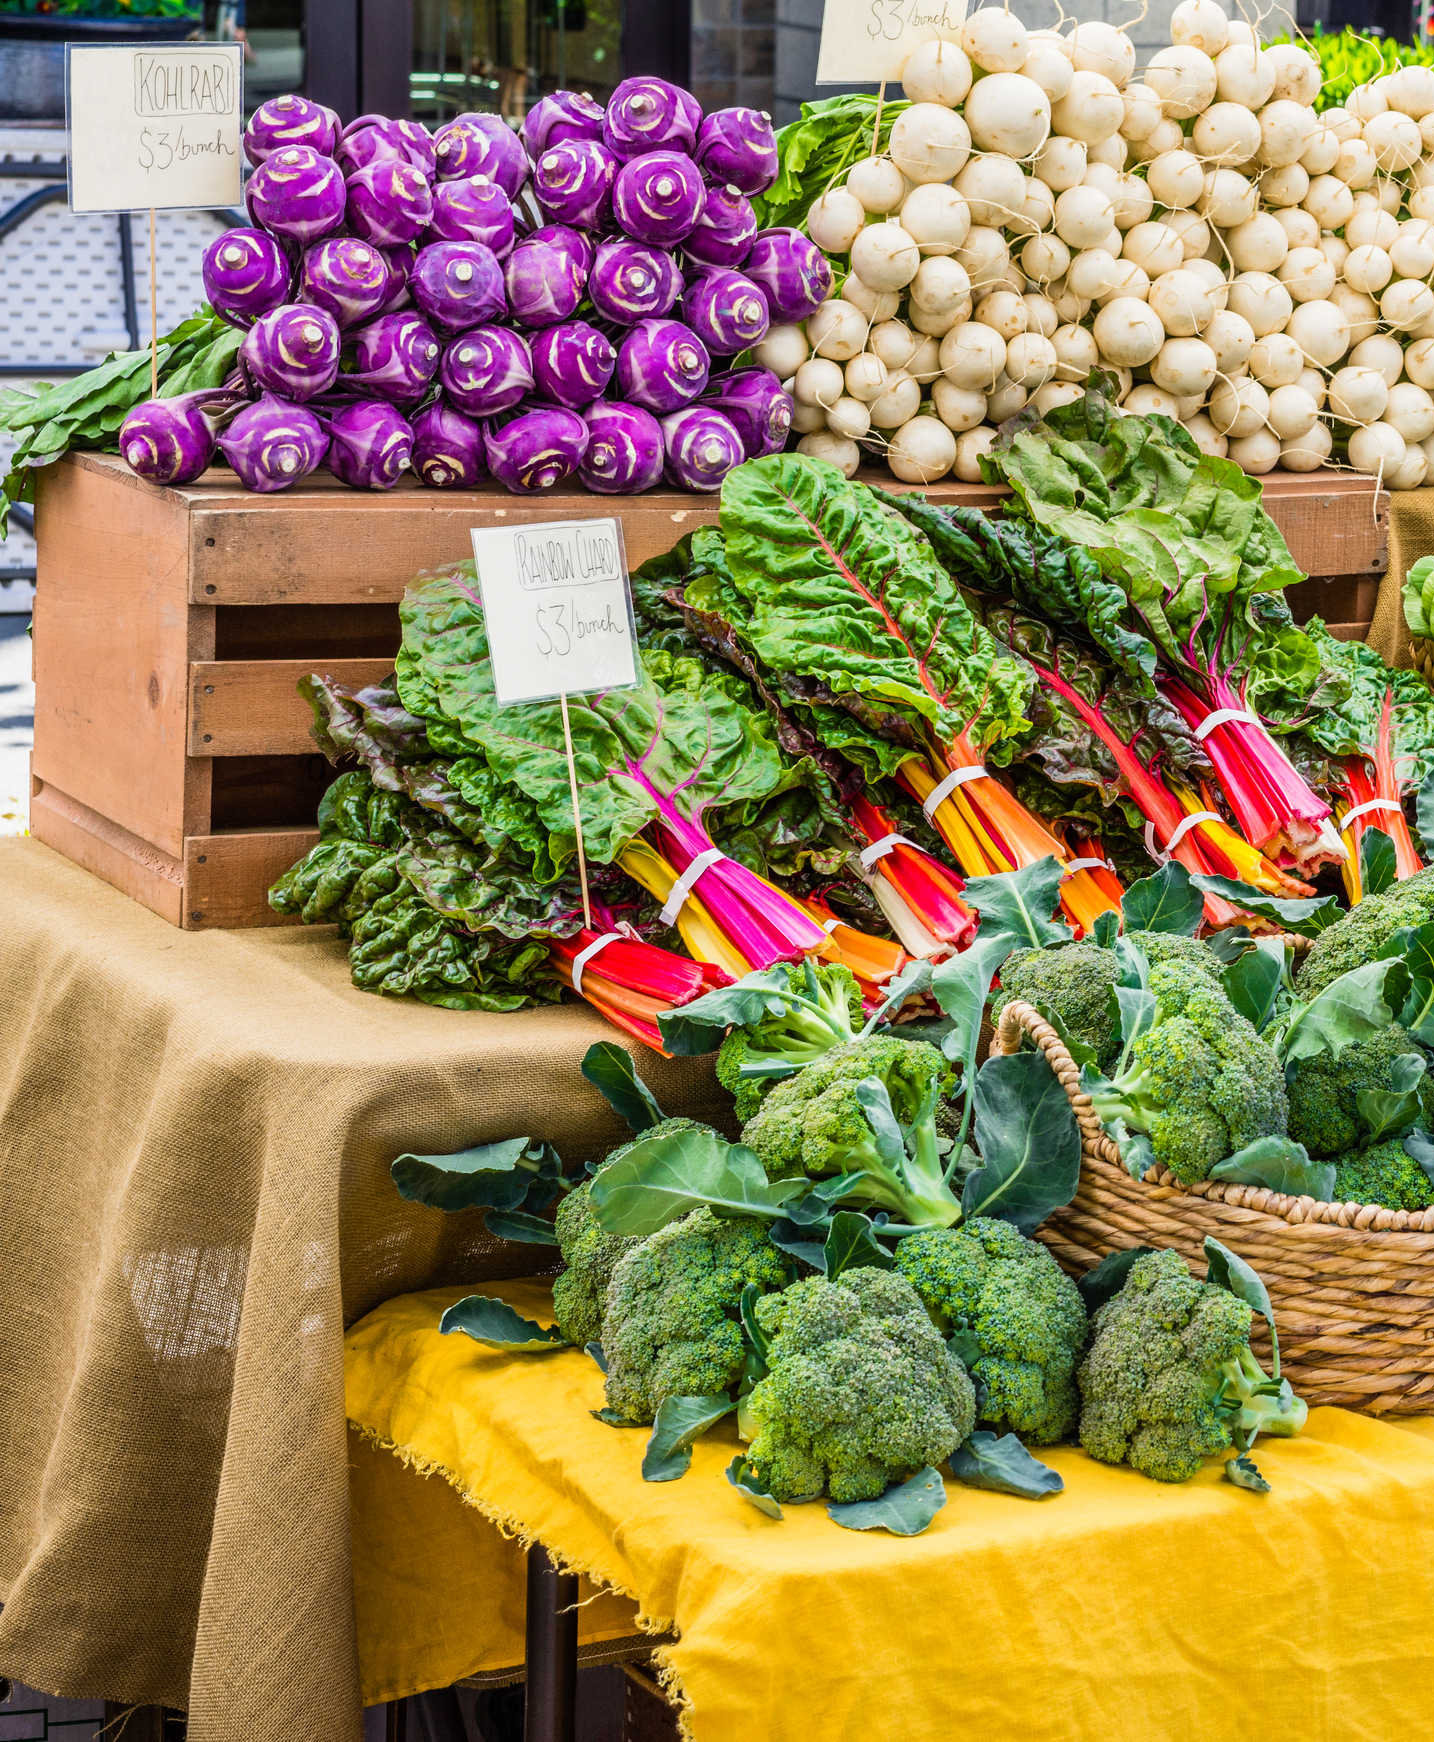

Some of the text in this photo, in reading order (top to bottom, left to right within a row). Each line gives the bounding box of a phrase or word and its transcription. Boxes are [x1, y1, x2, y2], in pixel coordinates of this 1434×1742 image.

[140, 58, 230, 114] KOHLRABI
[138, 126, 235, 173] $3/bunch
[517, 530, 614, 585] RAINBOW CHARD
[536, 599, 624, 660] $3/bunch
